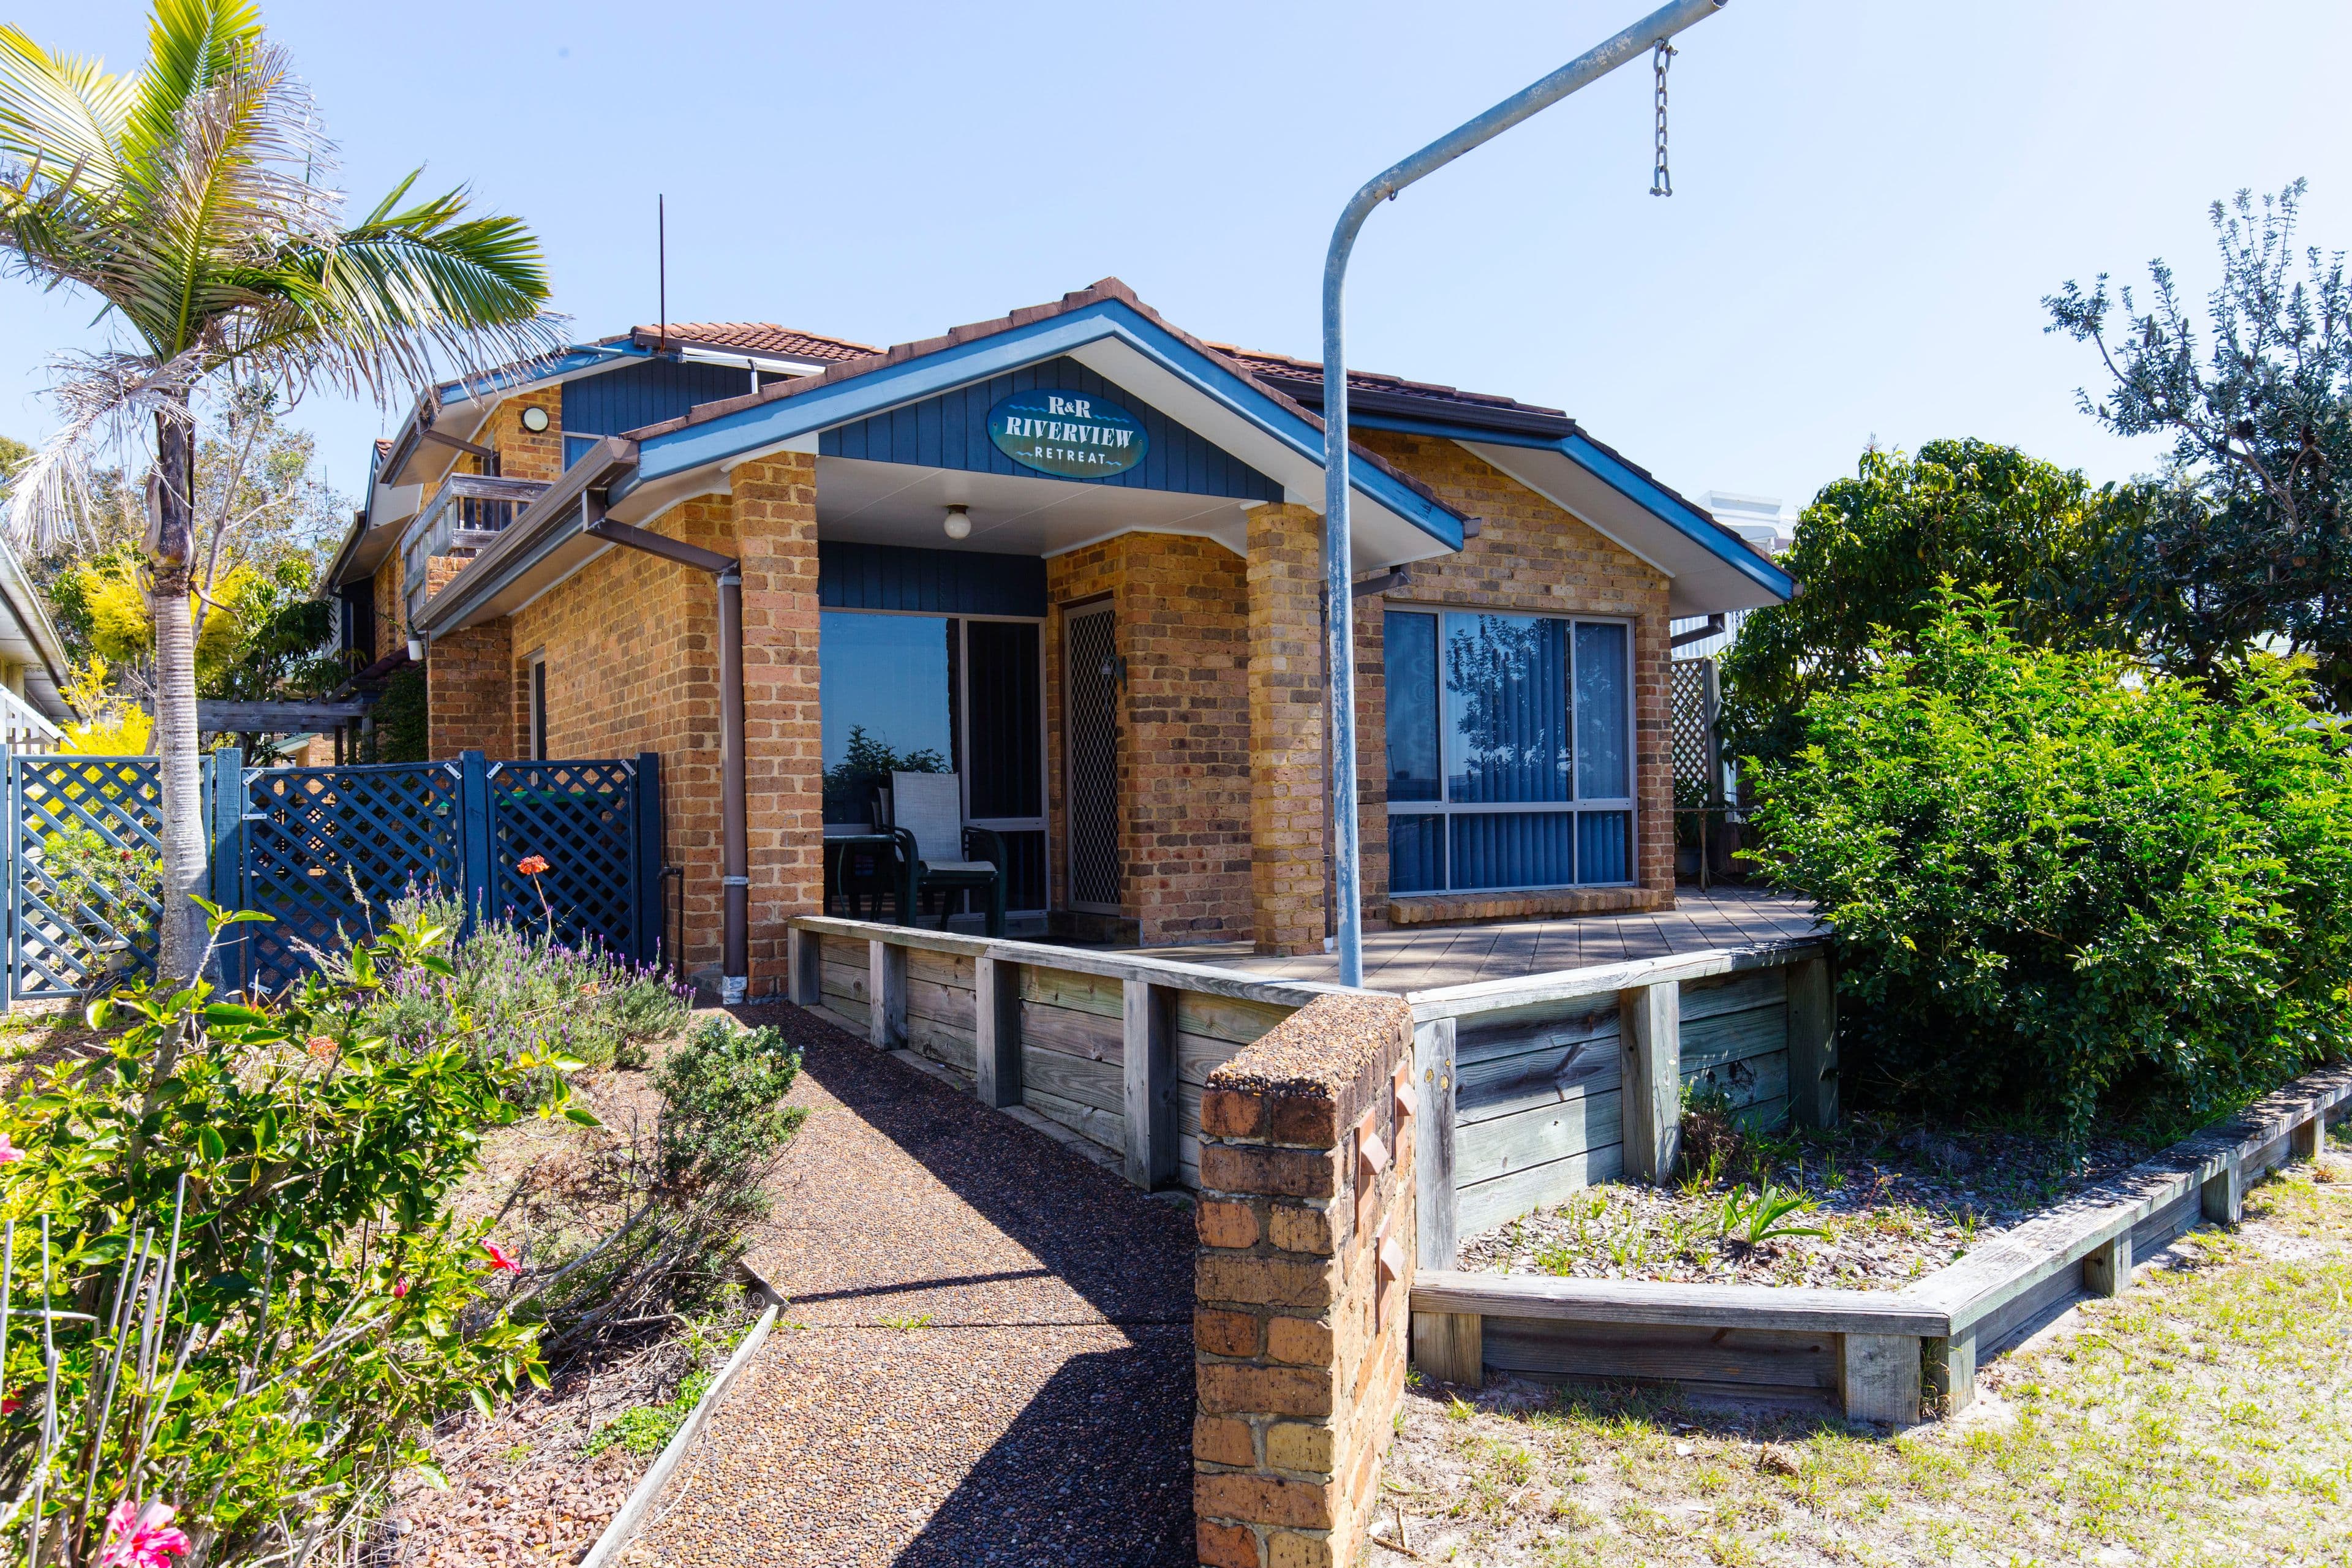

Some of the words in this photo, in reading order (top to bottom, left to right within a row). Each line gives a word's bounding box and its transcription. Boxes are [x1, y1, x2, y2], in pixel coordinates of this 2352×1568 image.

[1048, 396, 1091, 418] R&R
[1005, 416, 1134, 448] RIVERVIEW
[1035, 447, 1106, 464] RETREAT
